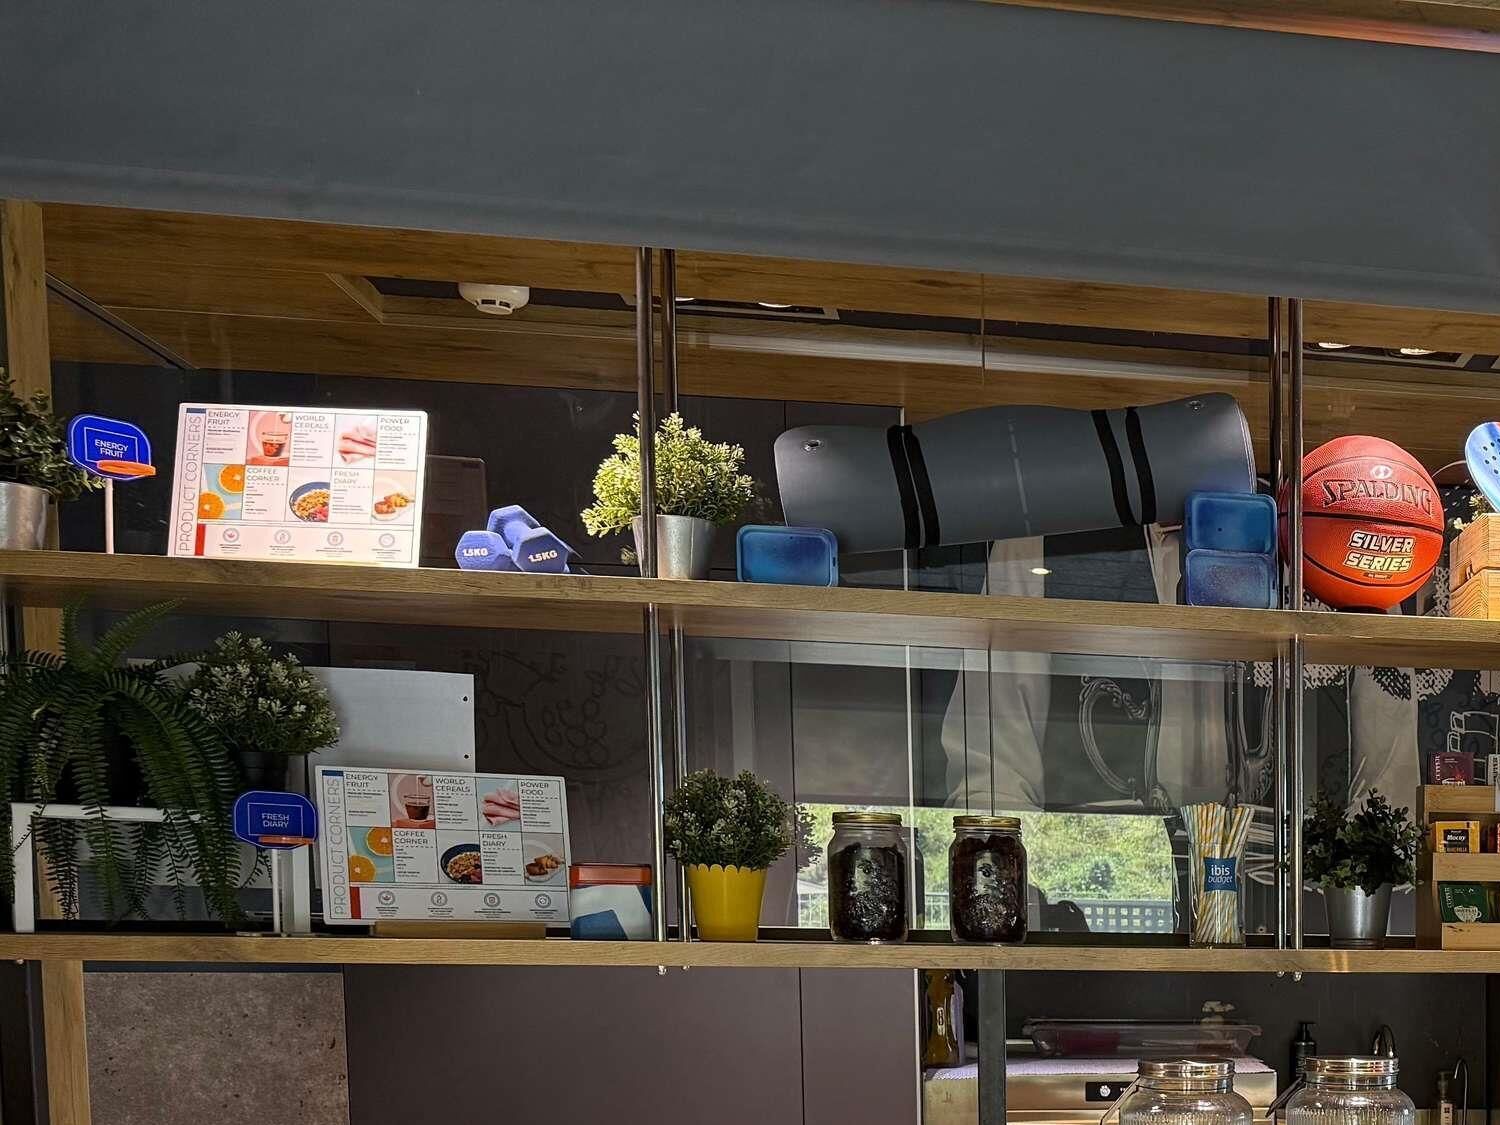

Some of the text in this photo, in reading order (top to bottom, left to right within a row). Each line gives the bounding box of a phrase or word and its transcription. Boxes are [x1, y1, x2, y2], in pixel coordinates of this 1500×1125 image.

[208, 411, 240, 419] ENERGY
[207, 418, 230, 426] FRUIT
[380, 417, 411, 425] POWER
[294, 422, 329, 430] CEREALS
[379, 424, 403, 432] FOOD
[94, 439, 128, 452] ENERGY
[100, 447, 125, 458] FRUIT
[333, 470, 360, 478] FRESH
[179, 416, 202, 552] PRODUCT CORNERS
[333, 477, 358, 485] DIARY
[1322, 479, 1434, 516] SPALDING
[1349, 531, 1416, 554] SILVER
[1345, 551, 1413, 572] SERIES
[345, 773, 379, 782] ENERGY
[436, 785, 471, 793] CEREALS
[520, 781, 550, 789] POWER
[520, 788, 544, 796] FOOD
[261, 812, 290, 821] FRESH
[262, 820, 289, 828] DIARY
[393, 830, 426, 838] COFFEE
[1446, 834, 1467, 842] Mocay
[394, 837, 428, 845] CORNER
[326, 778, 346, 915] PRODUCT CORNERS
[1210, 864, 1231, 876] ibis
[1208, 875, 1233, 884] budget
